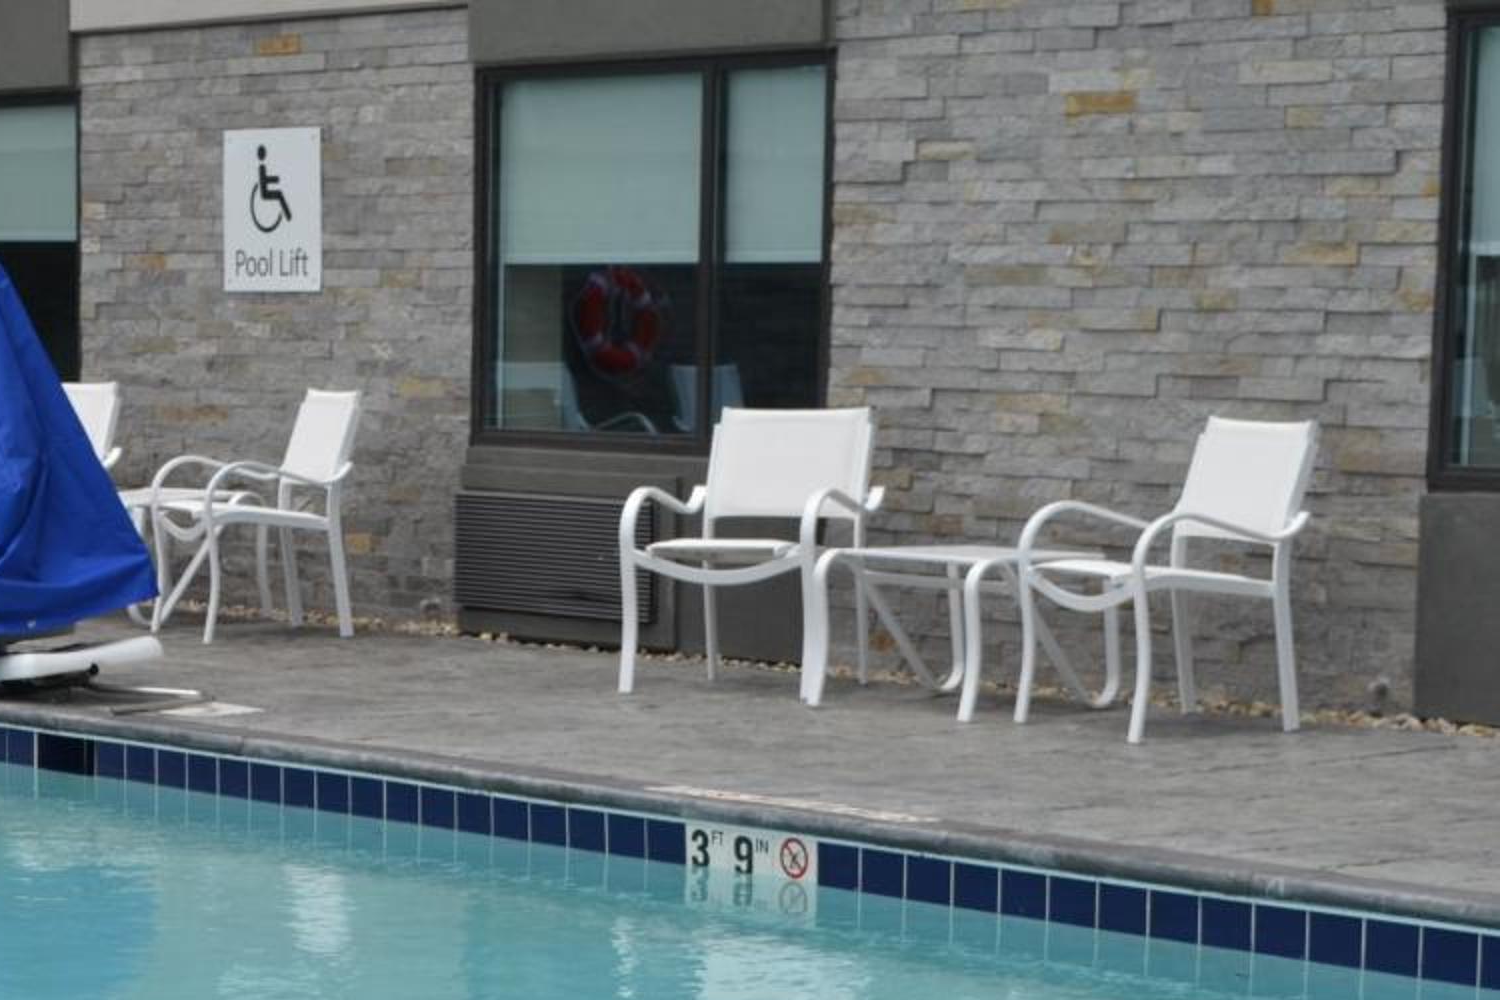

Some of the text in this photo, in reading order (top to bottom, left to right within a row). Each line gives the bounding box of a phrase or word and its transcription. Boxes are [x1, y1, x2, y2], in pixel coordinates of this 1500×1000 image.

[235, 248, 309, 277] Pool Lift
[691, 829, 769, 875] 3 FT 9 IN
